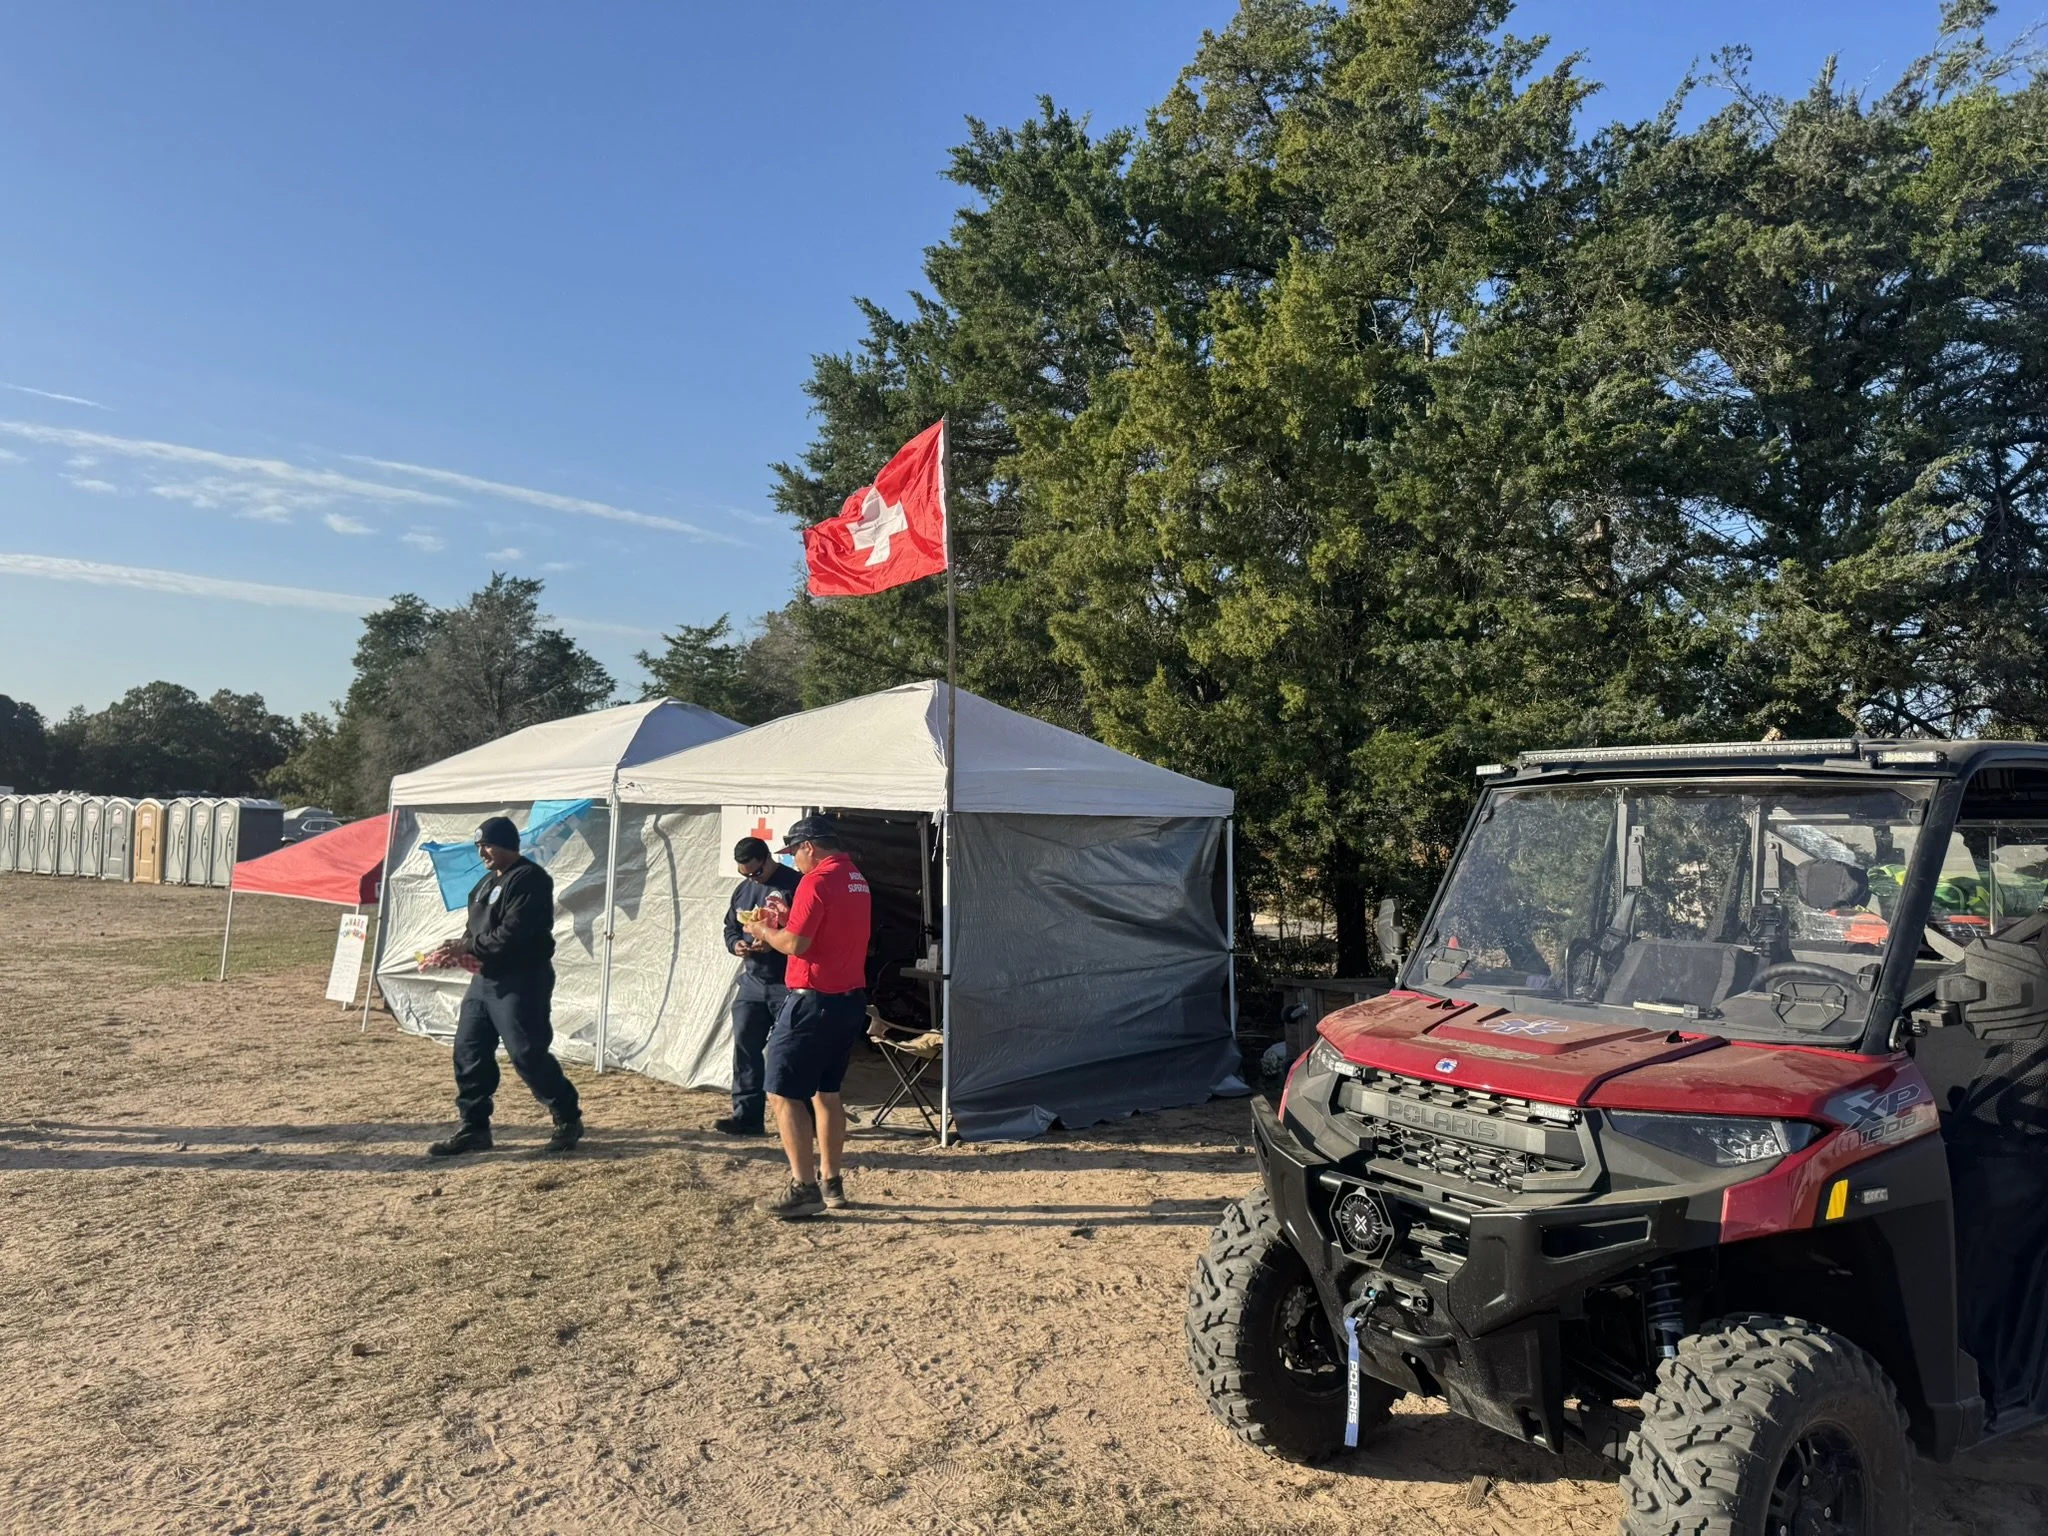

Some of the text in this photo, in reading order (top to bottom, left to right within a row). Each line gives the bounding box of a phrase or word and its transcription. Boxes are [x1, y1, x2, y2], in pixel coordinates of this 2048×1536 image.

[1387, 1099, 1498, 1140] POLARIS
[1861, 1112, 1917, 1146] 1000
[1348, 1360, 1358, 1424] POLARIS
